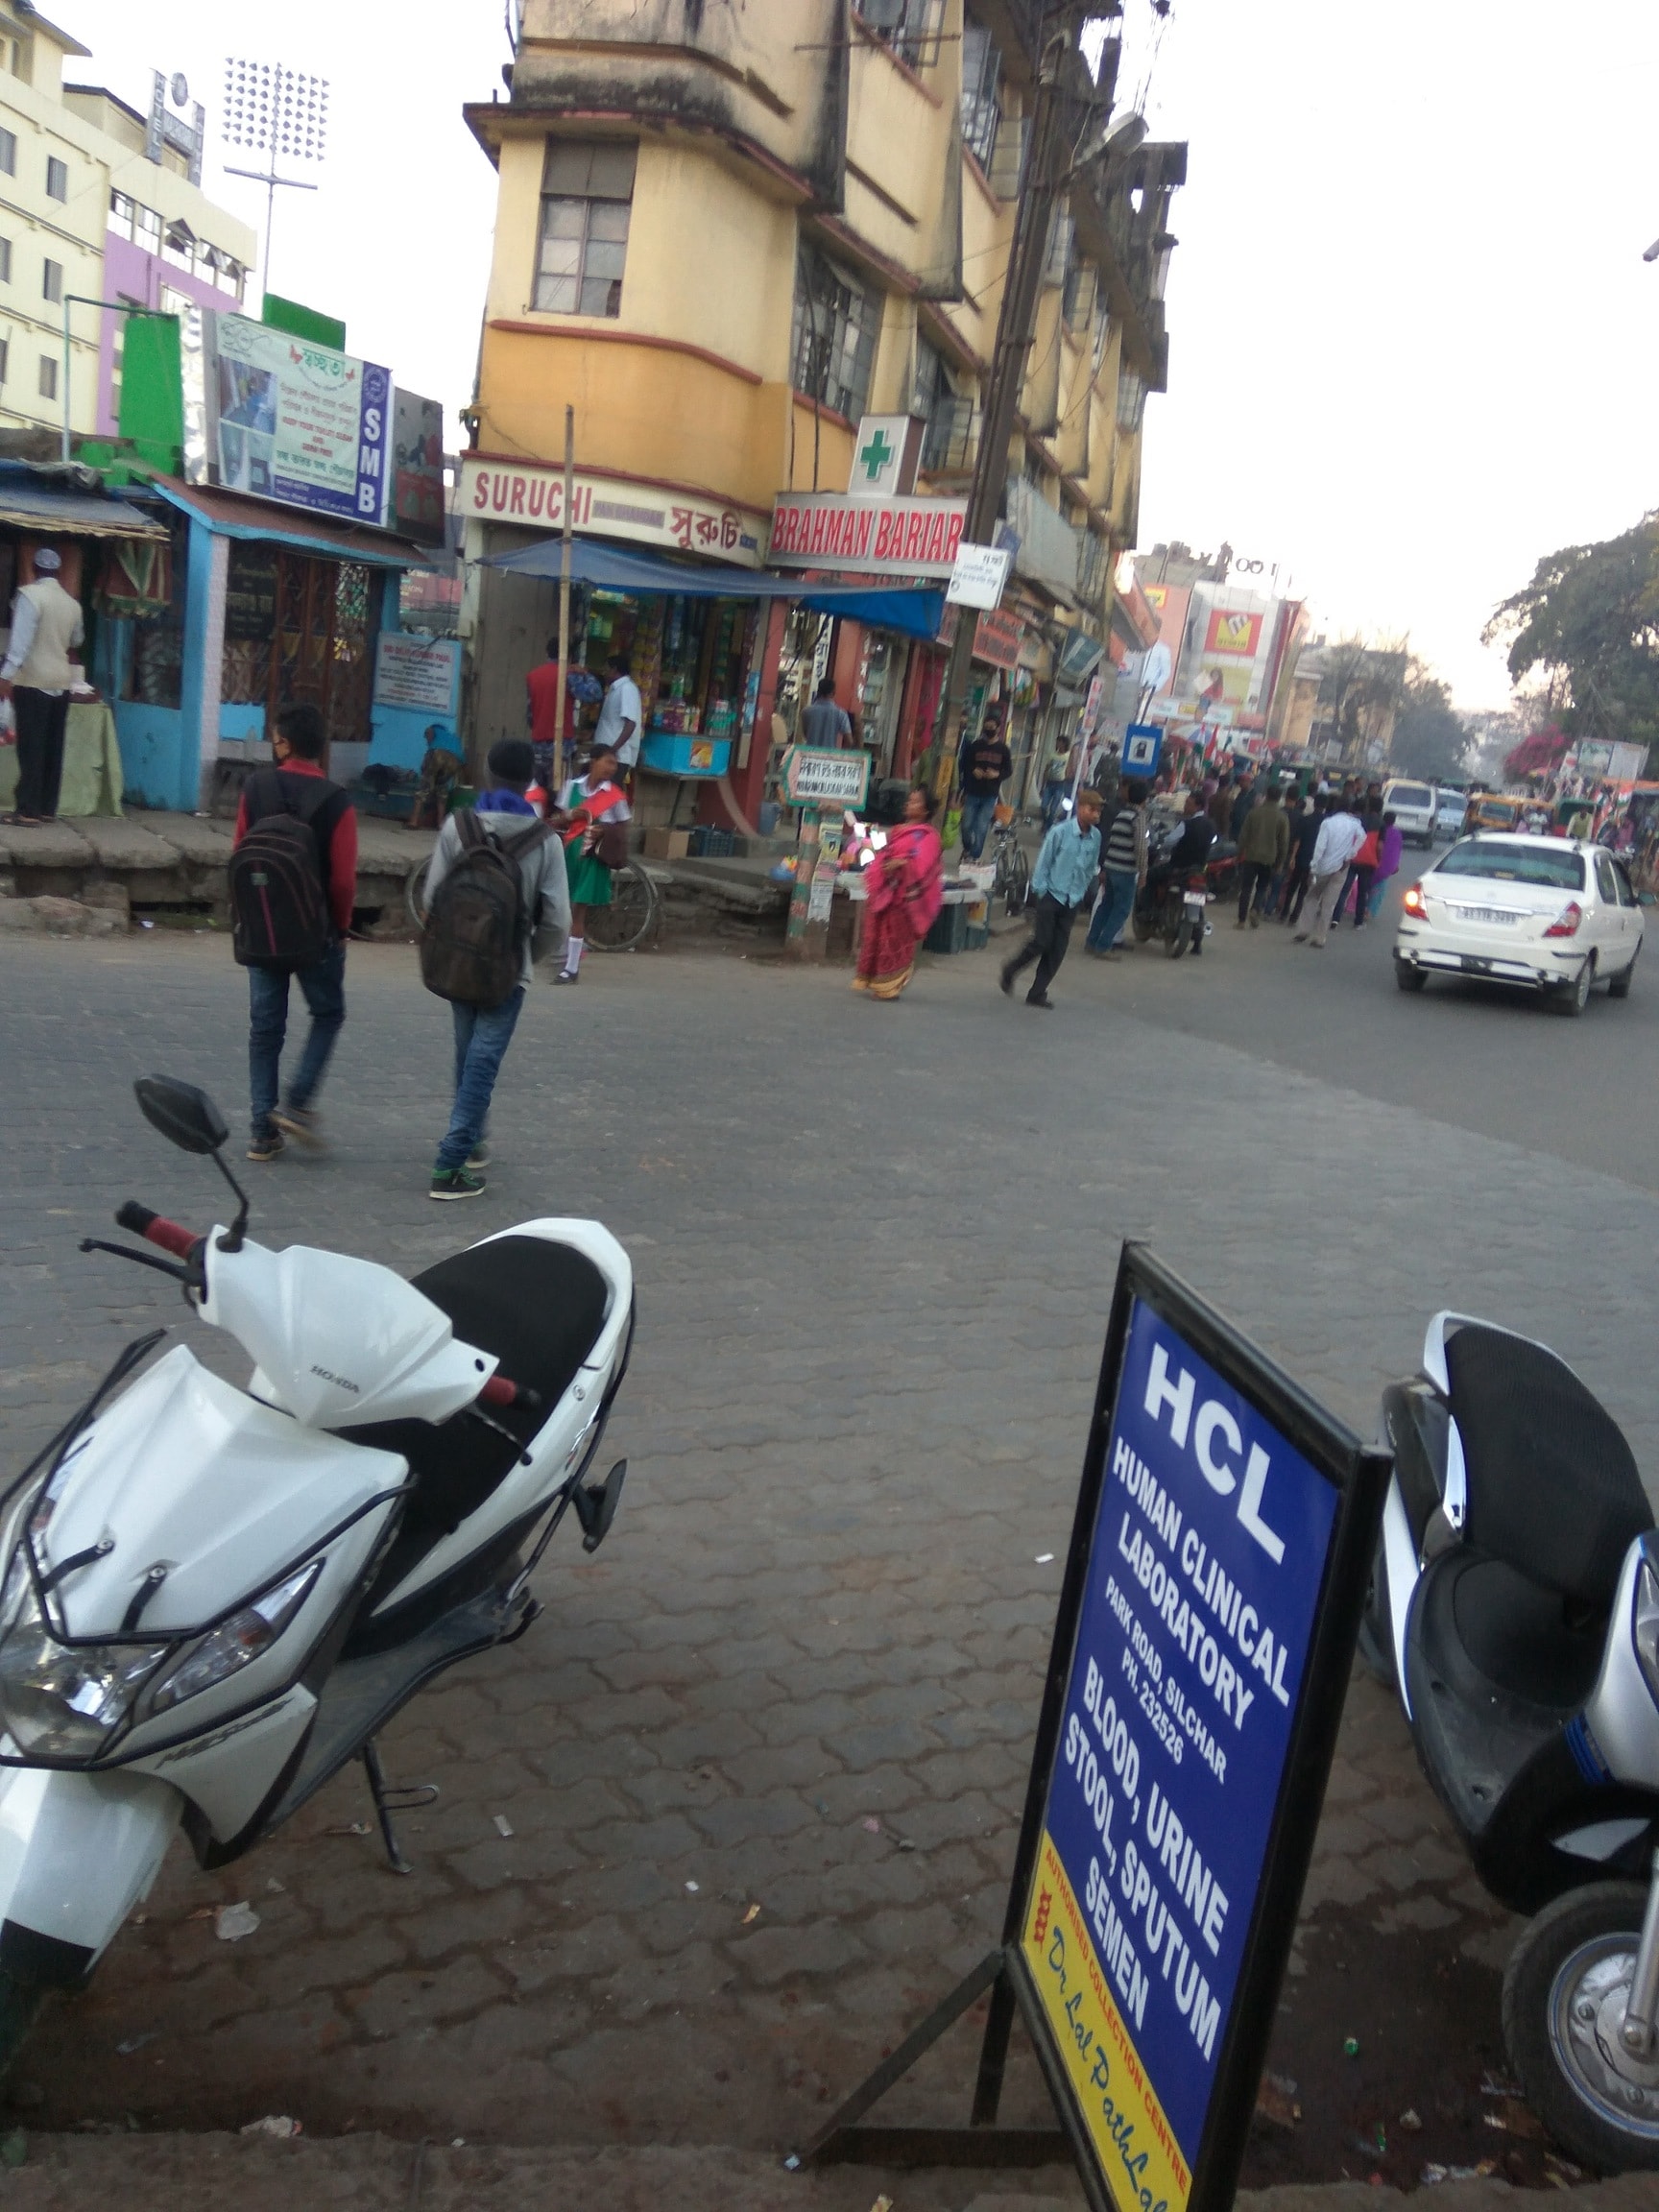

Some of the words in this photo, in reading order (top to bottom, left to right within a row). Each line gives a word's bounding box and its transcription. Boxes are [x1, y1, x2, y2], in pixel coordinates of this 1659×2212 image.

[473, 471, 593, 526] SURUCHI
[669, 504, 743, 551] সুরুচি
[770, 506, 875, 558] BRAHMAN
[1144, 1342, 1286, 1565] HCL
[1113, 1435, 1182, 1552] HUMAN
[1182, 1528, 1289, 1707] CLINICAL
[1118, 1511, 1254, 1731] LABORATORY
[1106, 1575, 1134, 1634] PARK
[1133, 1620, 1163, 1695] ROAD,
[1165, 1676, 1227, 1785] SILCHAR
[1121, 1647, 1139, 1695] PH.
[1140, 1681, 1183, 1765] 232526
[1065, 1712, 1117, 1876] STOOL,
[1121, 1839, 1223, 2062] SPUTUM
[1083, 1655, 1141, 1824] BLOOD,
[1147, 1781, 1229, 1957] URINE
[1045, 1847, 1090, 1960] AUTHORISED
[1088, 1960, 1142, 2094] COLLECTION
[1143, 2089, 1188, 2197] CENTRE
[1086, 1856, 1149, 2032] SEMEN
